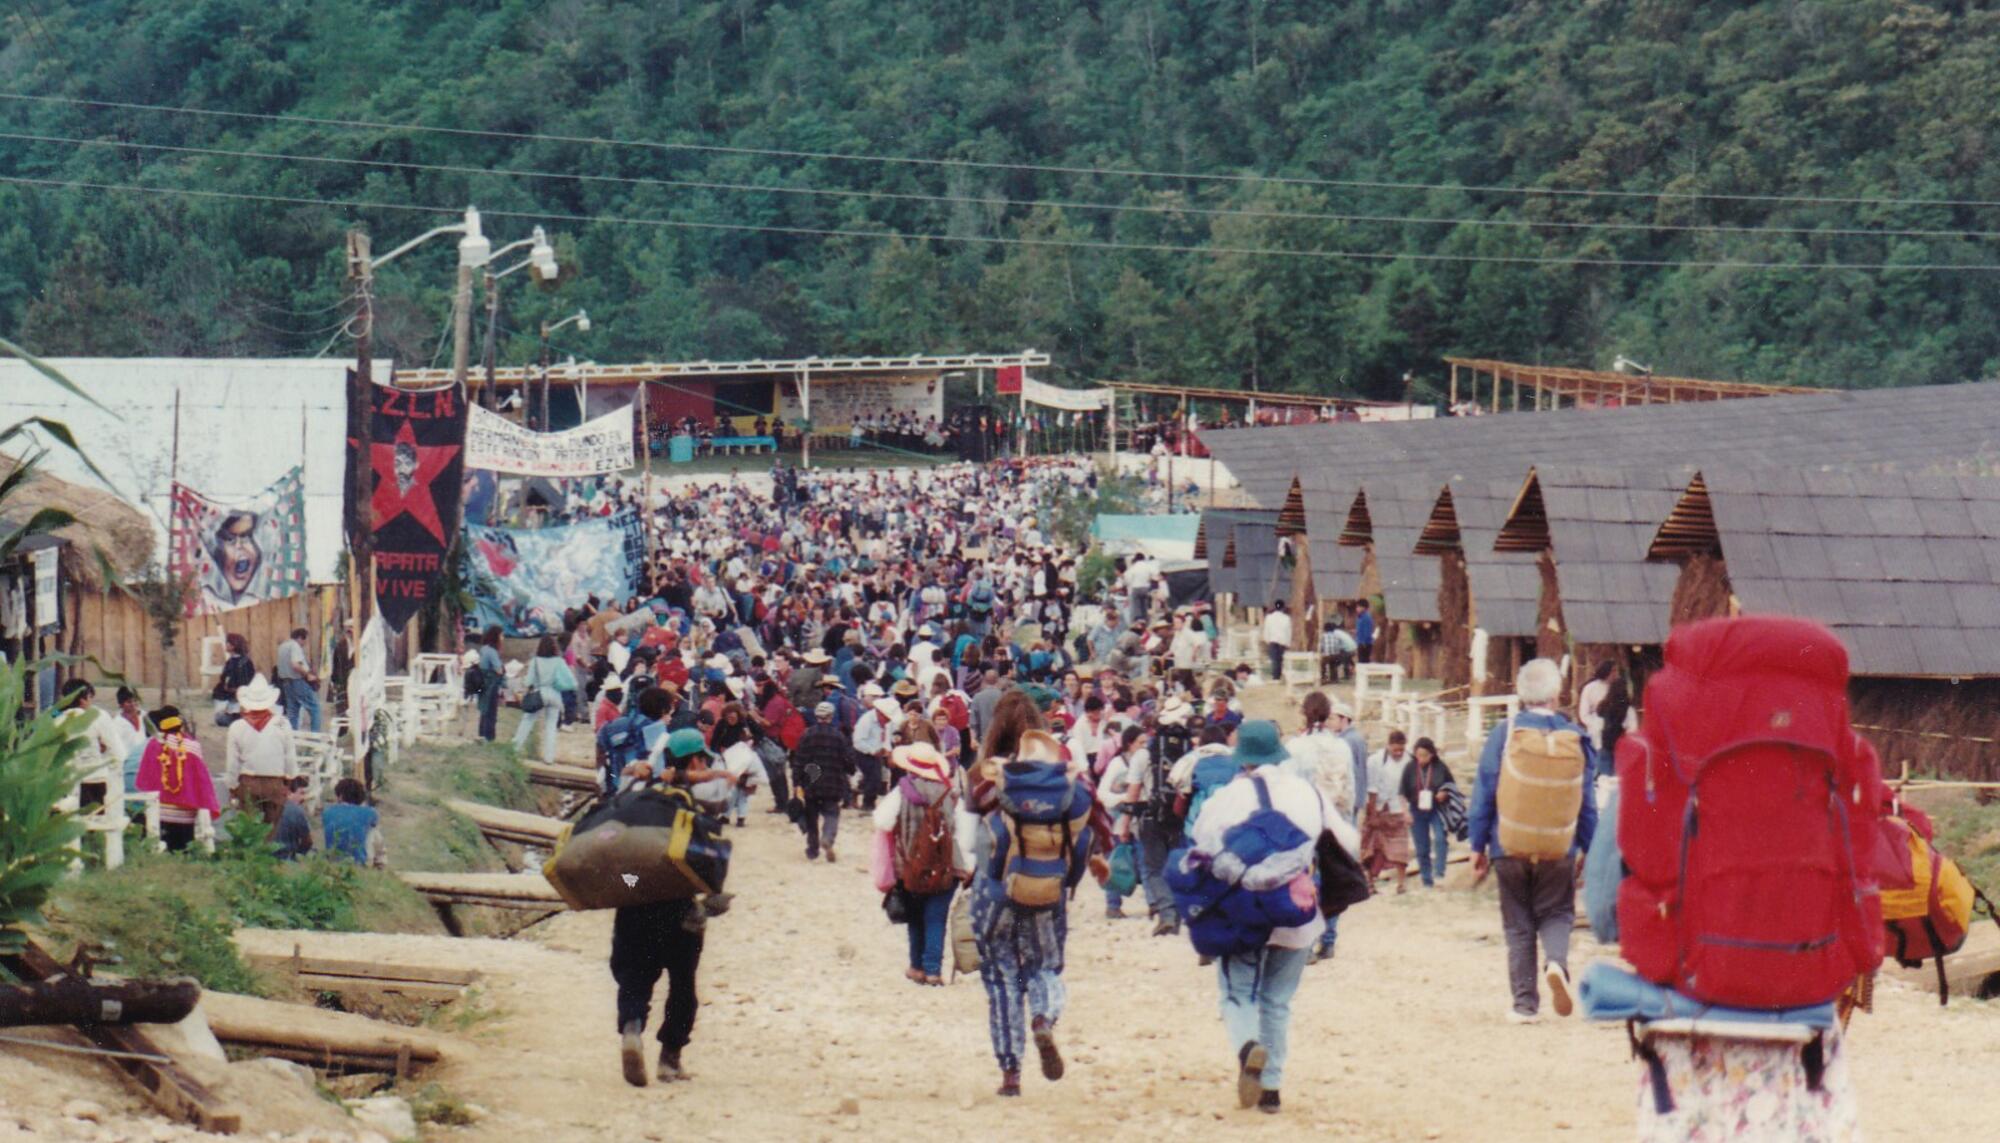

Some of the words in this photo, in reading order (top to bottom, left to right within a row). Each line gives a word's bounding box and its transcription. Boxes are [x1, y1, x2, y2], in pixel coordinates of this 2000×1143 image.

[596, 456, 632, 472] EZLN
[374, 551, 439, 571] APATA
[376, 579, 426, 598] VIVE
